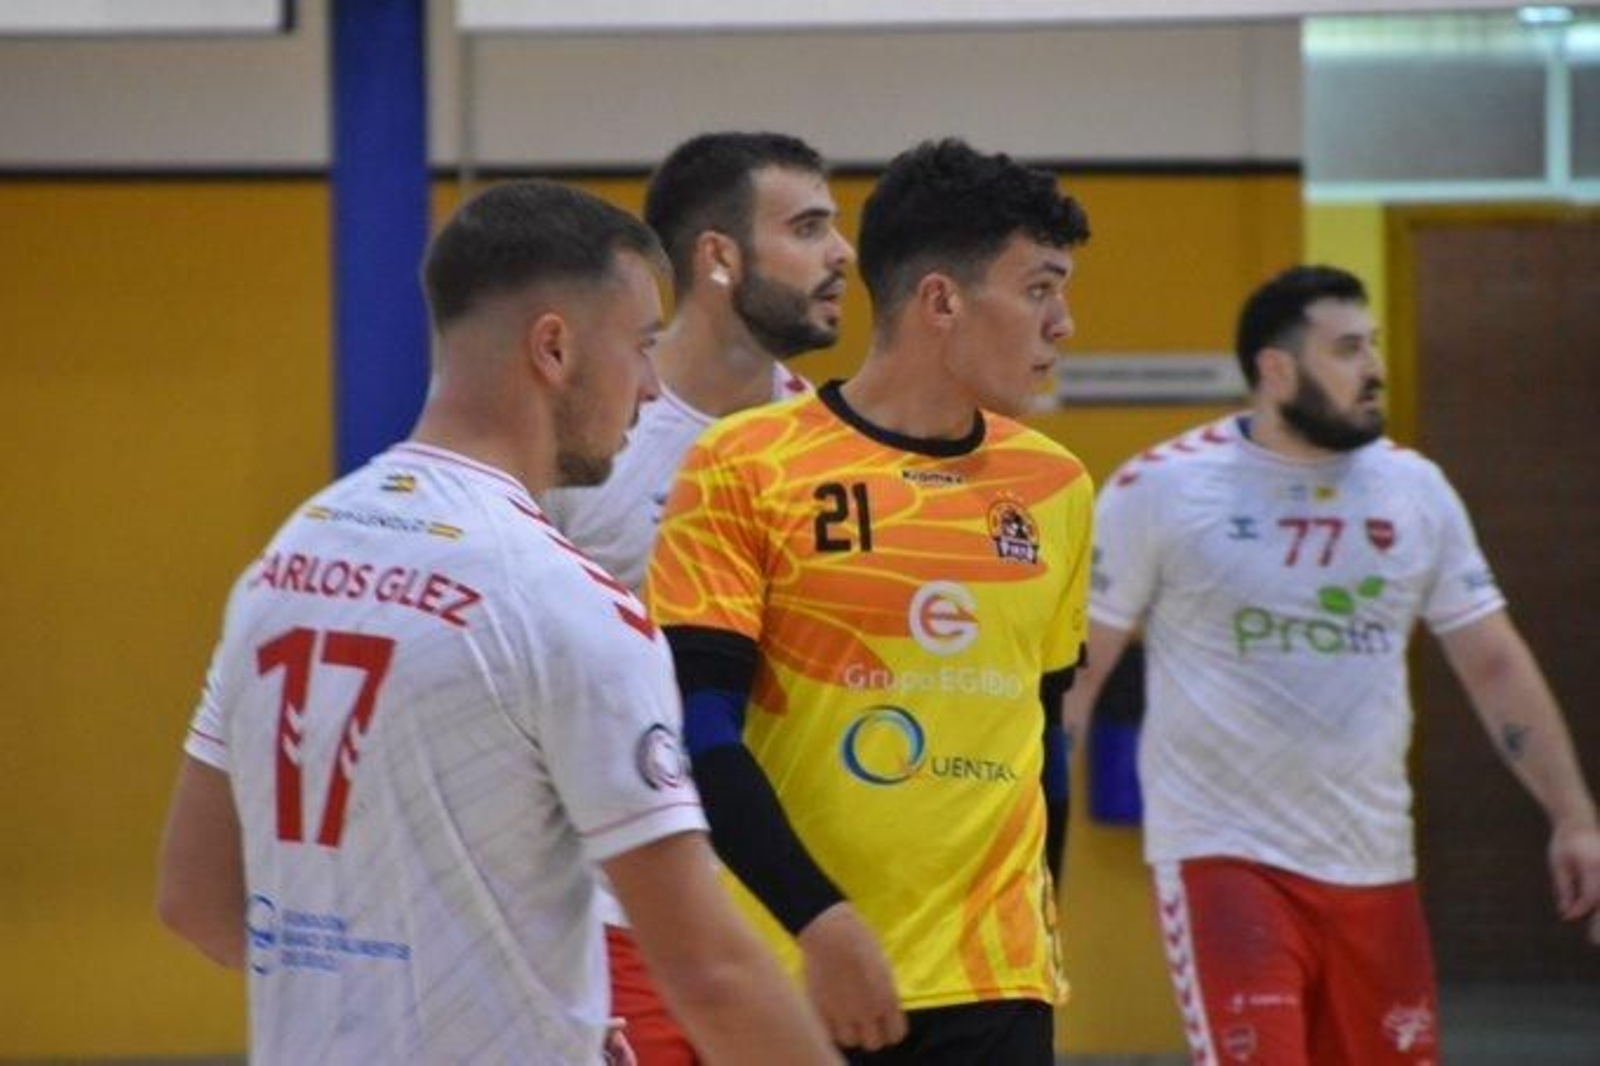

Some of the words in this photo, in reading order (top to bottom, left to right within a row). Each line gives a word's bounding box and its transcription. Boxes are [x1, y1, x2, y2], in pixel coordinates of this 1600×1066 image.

[813, 482, 873, 553] 21
[1278, 517, 1345, 567] 77
[374, 565, 482, 627] GLEZ
[843, 662, 936, 697] Grupo
[938, 667, 1024, 700] EGIDO
[256, 627, 396, 849] 17
